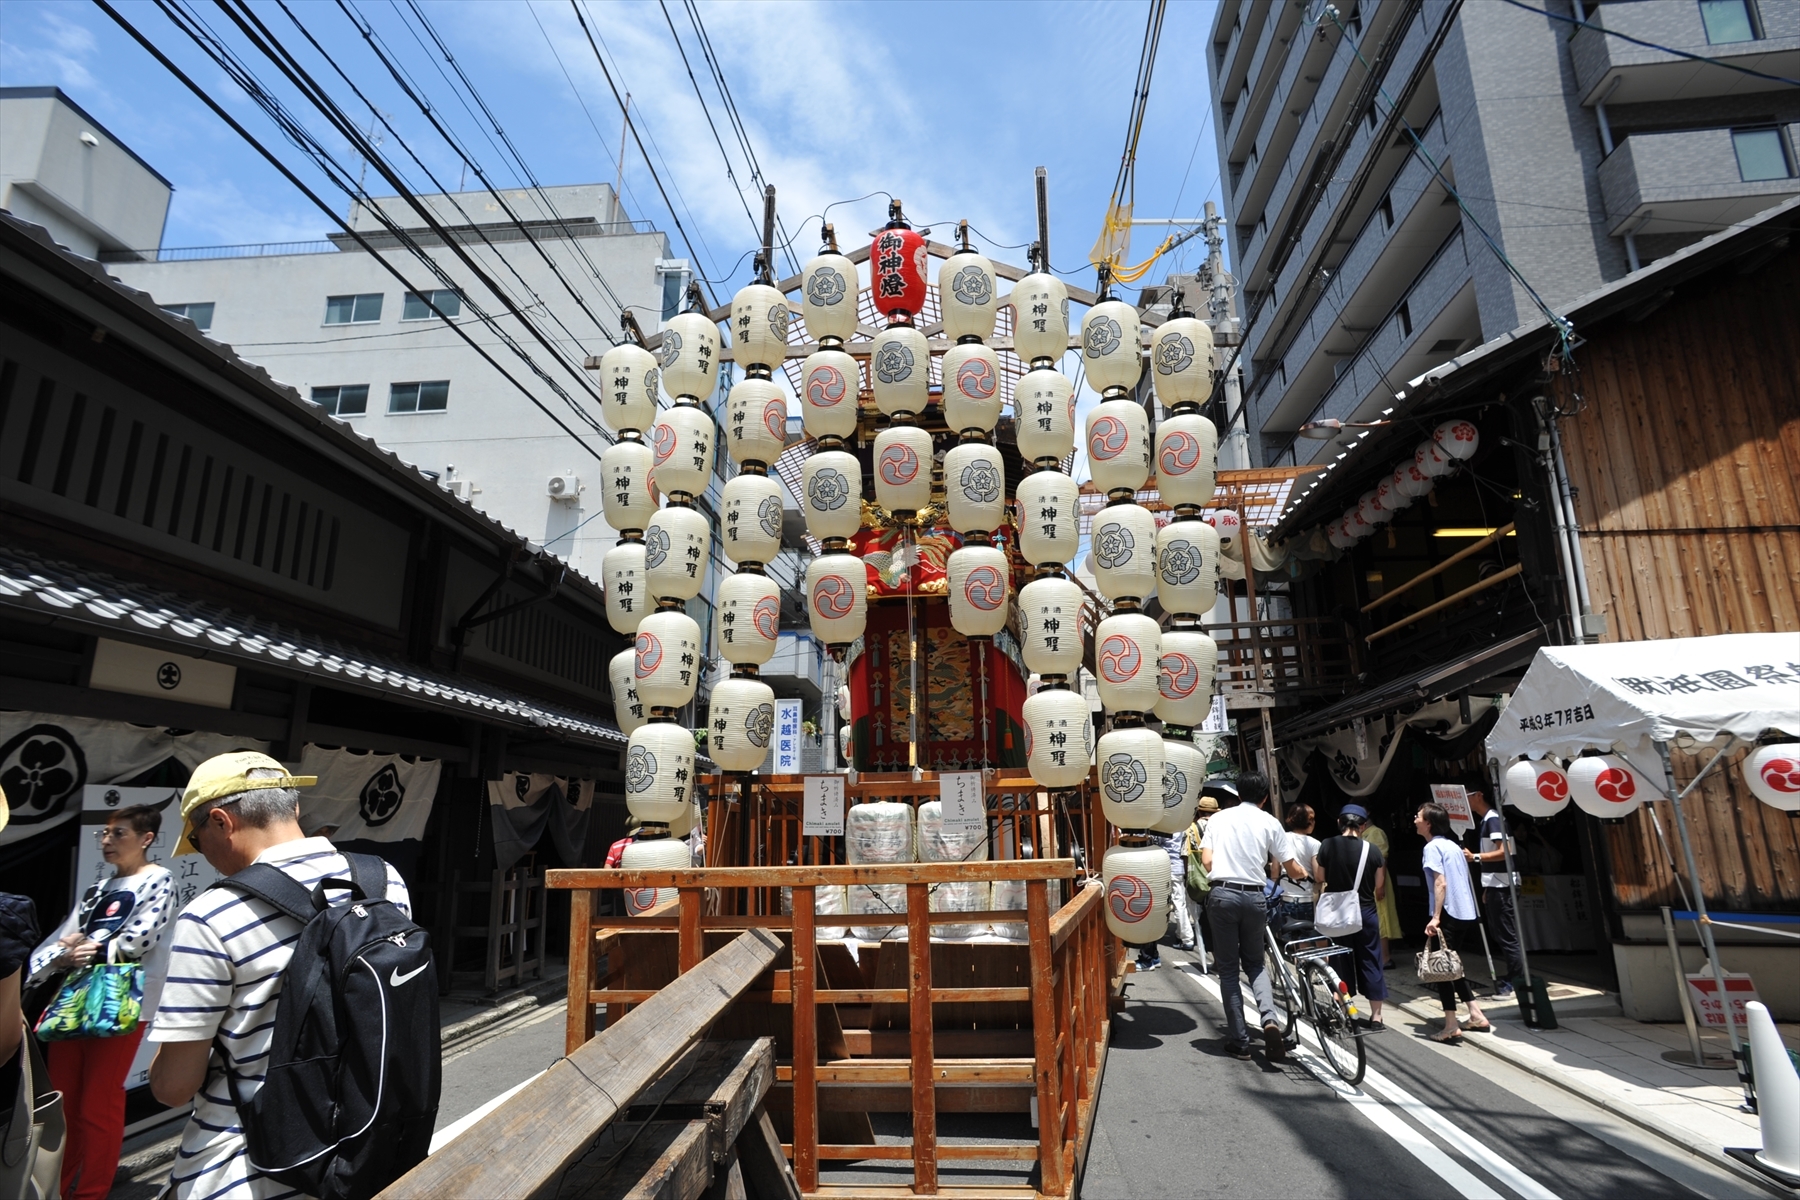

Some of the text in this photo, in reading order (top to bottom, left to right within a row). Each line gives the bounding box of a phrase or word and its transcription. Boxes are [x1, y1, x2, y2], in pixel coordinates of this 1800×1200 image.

[878, 232, 905, 298] 御神燈
[780, 708, 792, 767] 水越医院
[1519, 703, 1594, 732] 平成9年7月吉日
